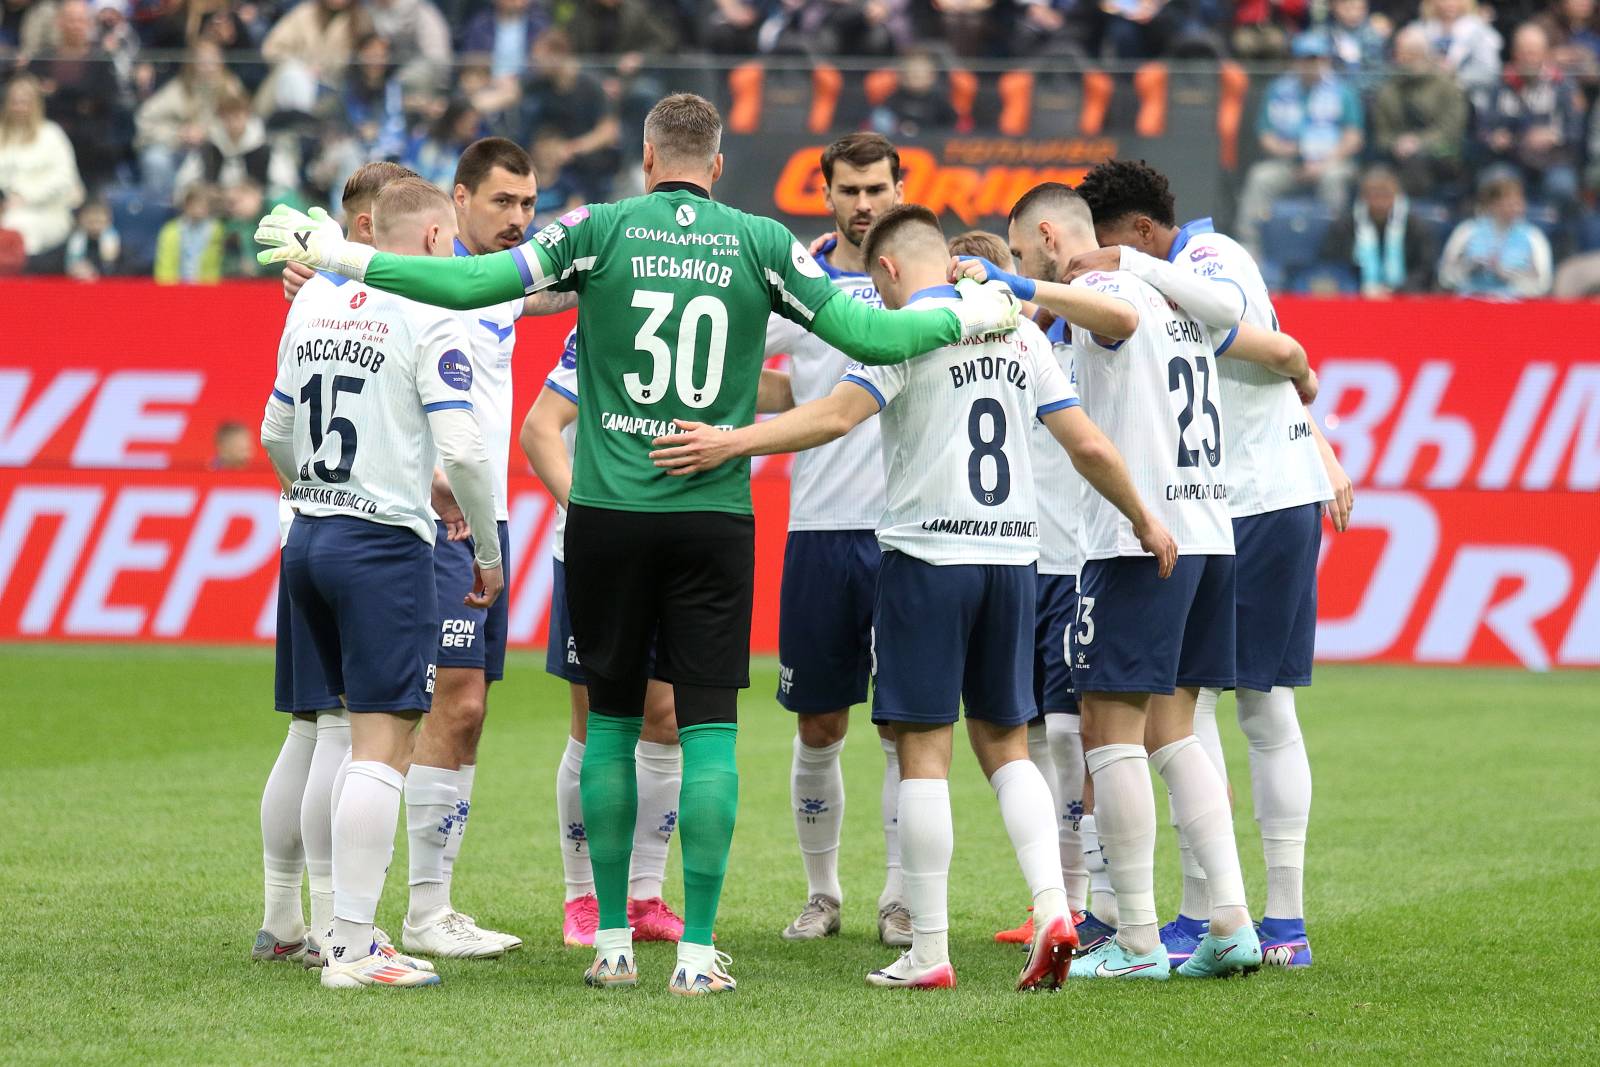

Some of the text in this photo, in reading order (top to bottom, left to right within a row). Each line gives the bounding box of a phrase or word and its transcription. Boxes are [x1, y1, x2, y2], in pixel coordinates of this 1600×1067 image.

[625, 226, 740, 247] СОЛИДАРНОСТЬ
[712, 248, 740, 257] БАНК
[631, 255, 733, 288] ПЕСЬЯКОВ
[361, 333, 385, 344] БАНК
[623, 289, 729, 409] 30
[296, 338, 386, 374] РАССКАЗОВ
[1167, 355, 1221, 468] 23
[300, 372, 366, 484] 15
[601, 411, 677, 437] САМАРСКАЯ
[967, 397, 1011, 506] 8
[283, 486, 333, 506] АМАРСКАЯ
[1000, 520, 1039, 538] ОБЛАС
[442, 619, 476, 634] FON
[442, 634, 476, 648] BET
[575, 841, 582, 852] 2
